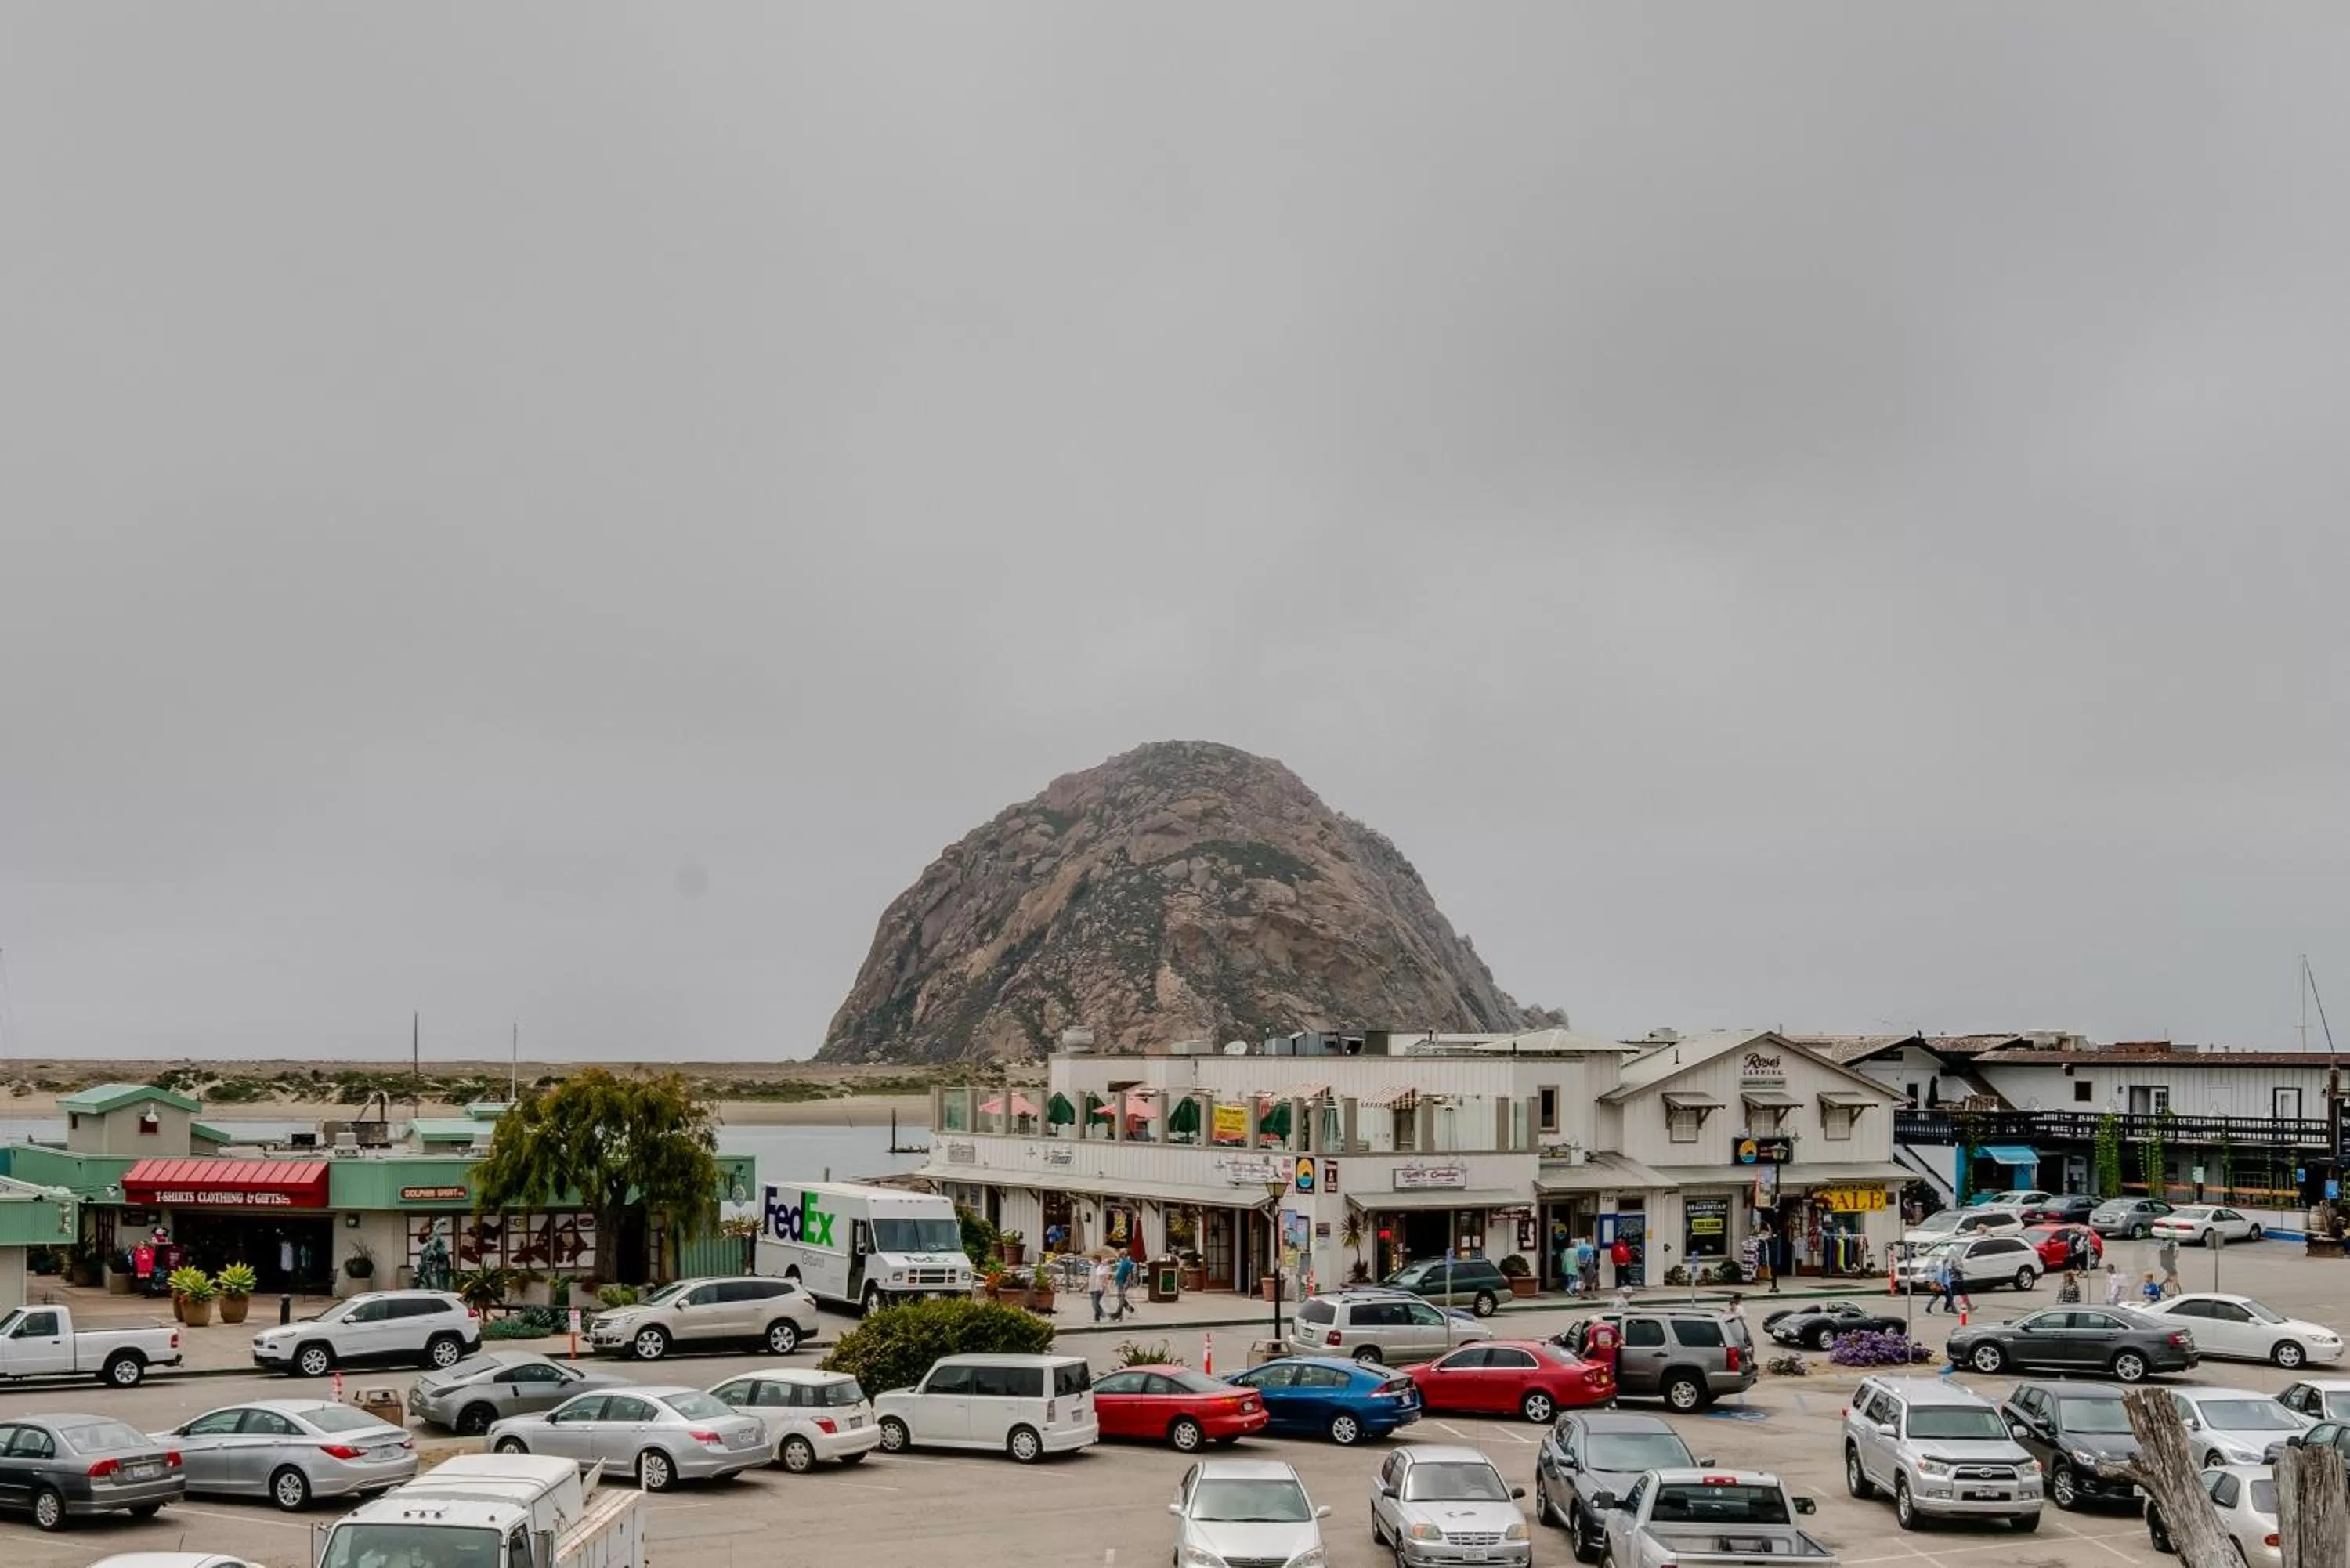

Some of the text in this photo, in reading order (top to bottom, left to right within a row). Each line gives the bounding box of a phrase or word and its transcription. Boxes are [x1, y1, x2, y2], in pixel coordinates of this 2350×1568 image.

[1743, 1053, 1781, 1068] Rose's
[155, 1191, 195, 1202] T-SHIRTS
[197, 1191, 244, 1203] CLOTHING
[255, 1192, 280, 1204] GIFTS
[1820, 1191, 1883, 1210] SALE
[765, 1185, 836, 1247] FedEx
